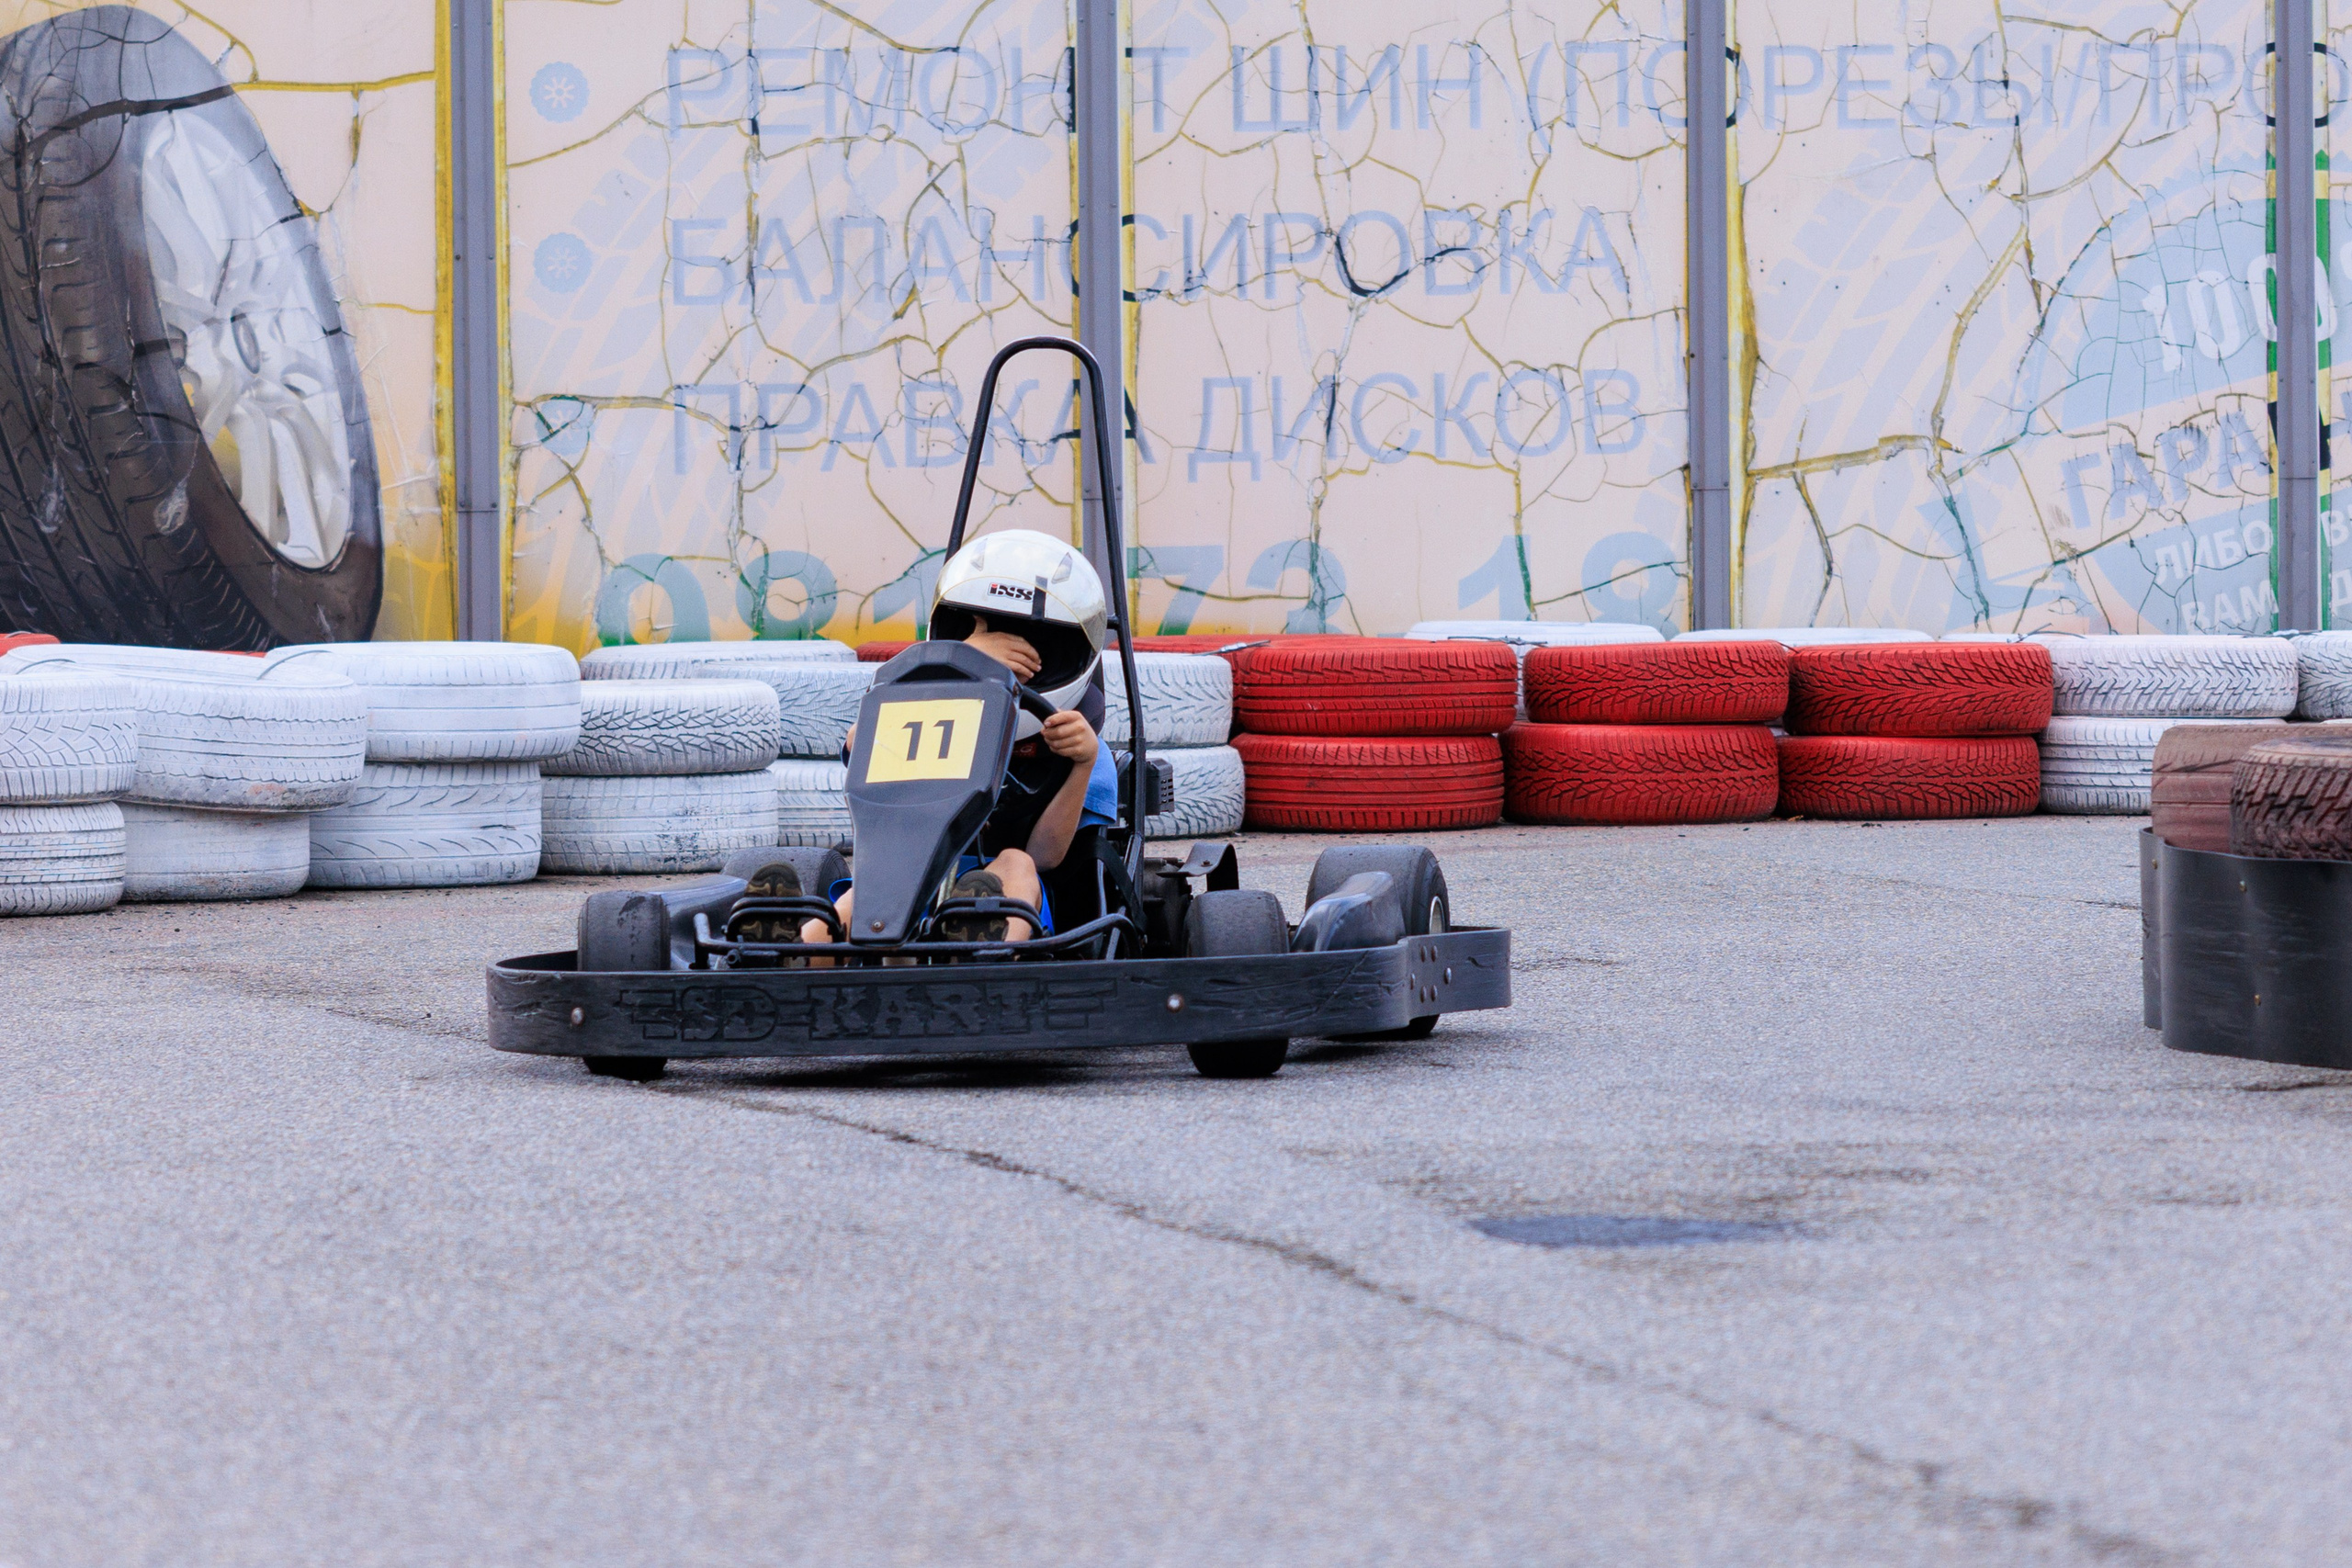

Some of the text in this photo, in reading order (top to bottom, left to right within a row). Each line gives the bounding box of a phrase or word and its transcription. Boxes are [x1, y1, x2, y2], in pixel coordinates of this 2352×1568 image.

[665, 45, 1195, 139] РЕМОНТ
[1231, 42, 1482, 134] ШИН
[671, 207, 1629, 306] БАЛАНСИРОВКА
[672, 370, 1647, 483] ПРАВКА ДИСКОВ
[2154, 518, 2275, 585] ЛИБО
[901, 719, 955, 761] 11
